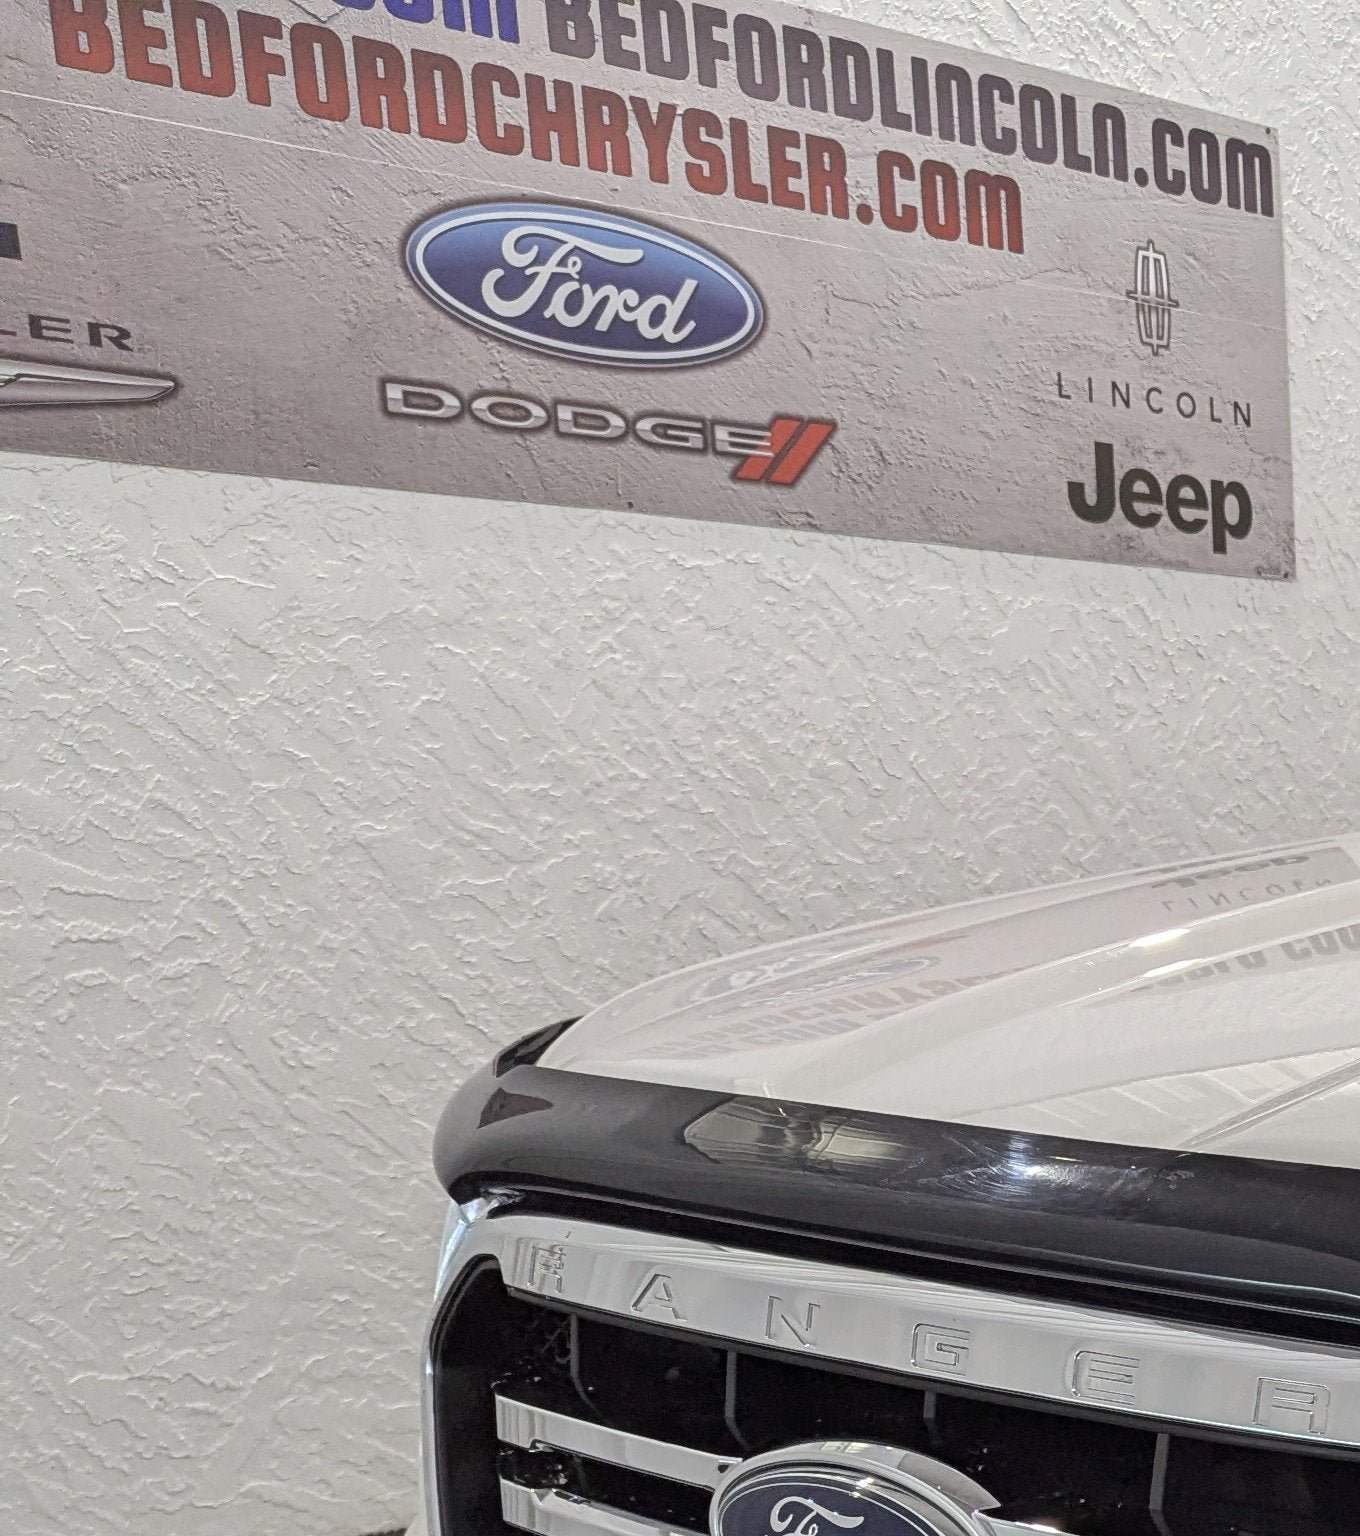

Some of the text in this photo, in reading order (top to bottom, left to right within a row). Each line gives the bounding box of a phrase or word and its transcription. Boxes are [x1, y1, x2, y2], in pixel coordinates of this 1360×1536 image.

[480, 225, 698, 344] Ford
[384, 380, 775, 458] DODGE
[1057, 371, 1252, 429] LINCOLN
[1067, 440, 1253, 555] Jeep
[525, 1244, 1332, 1434] RANGER
